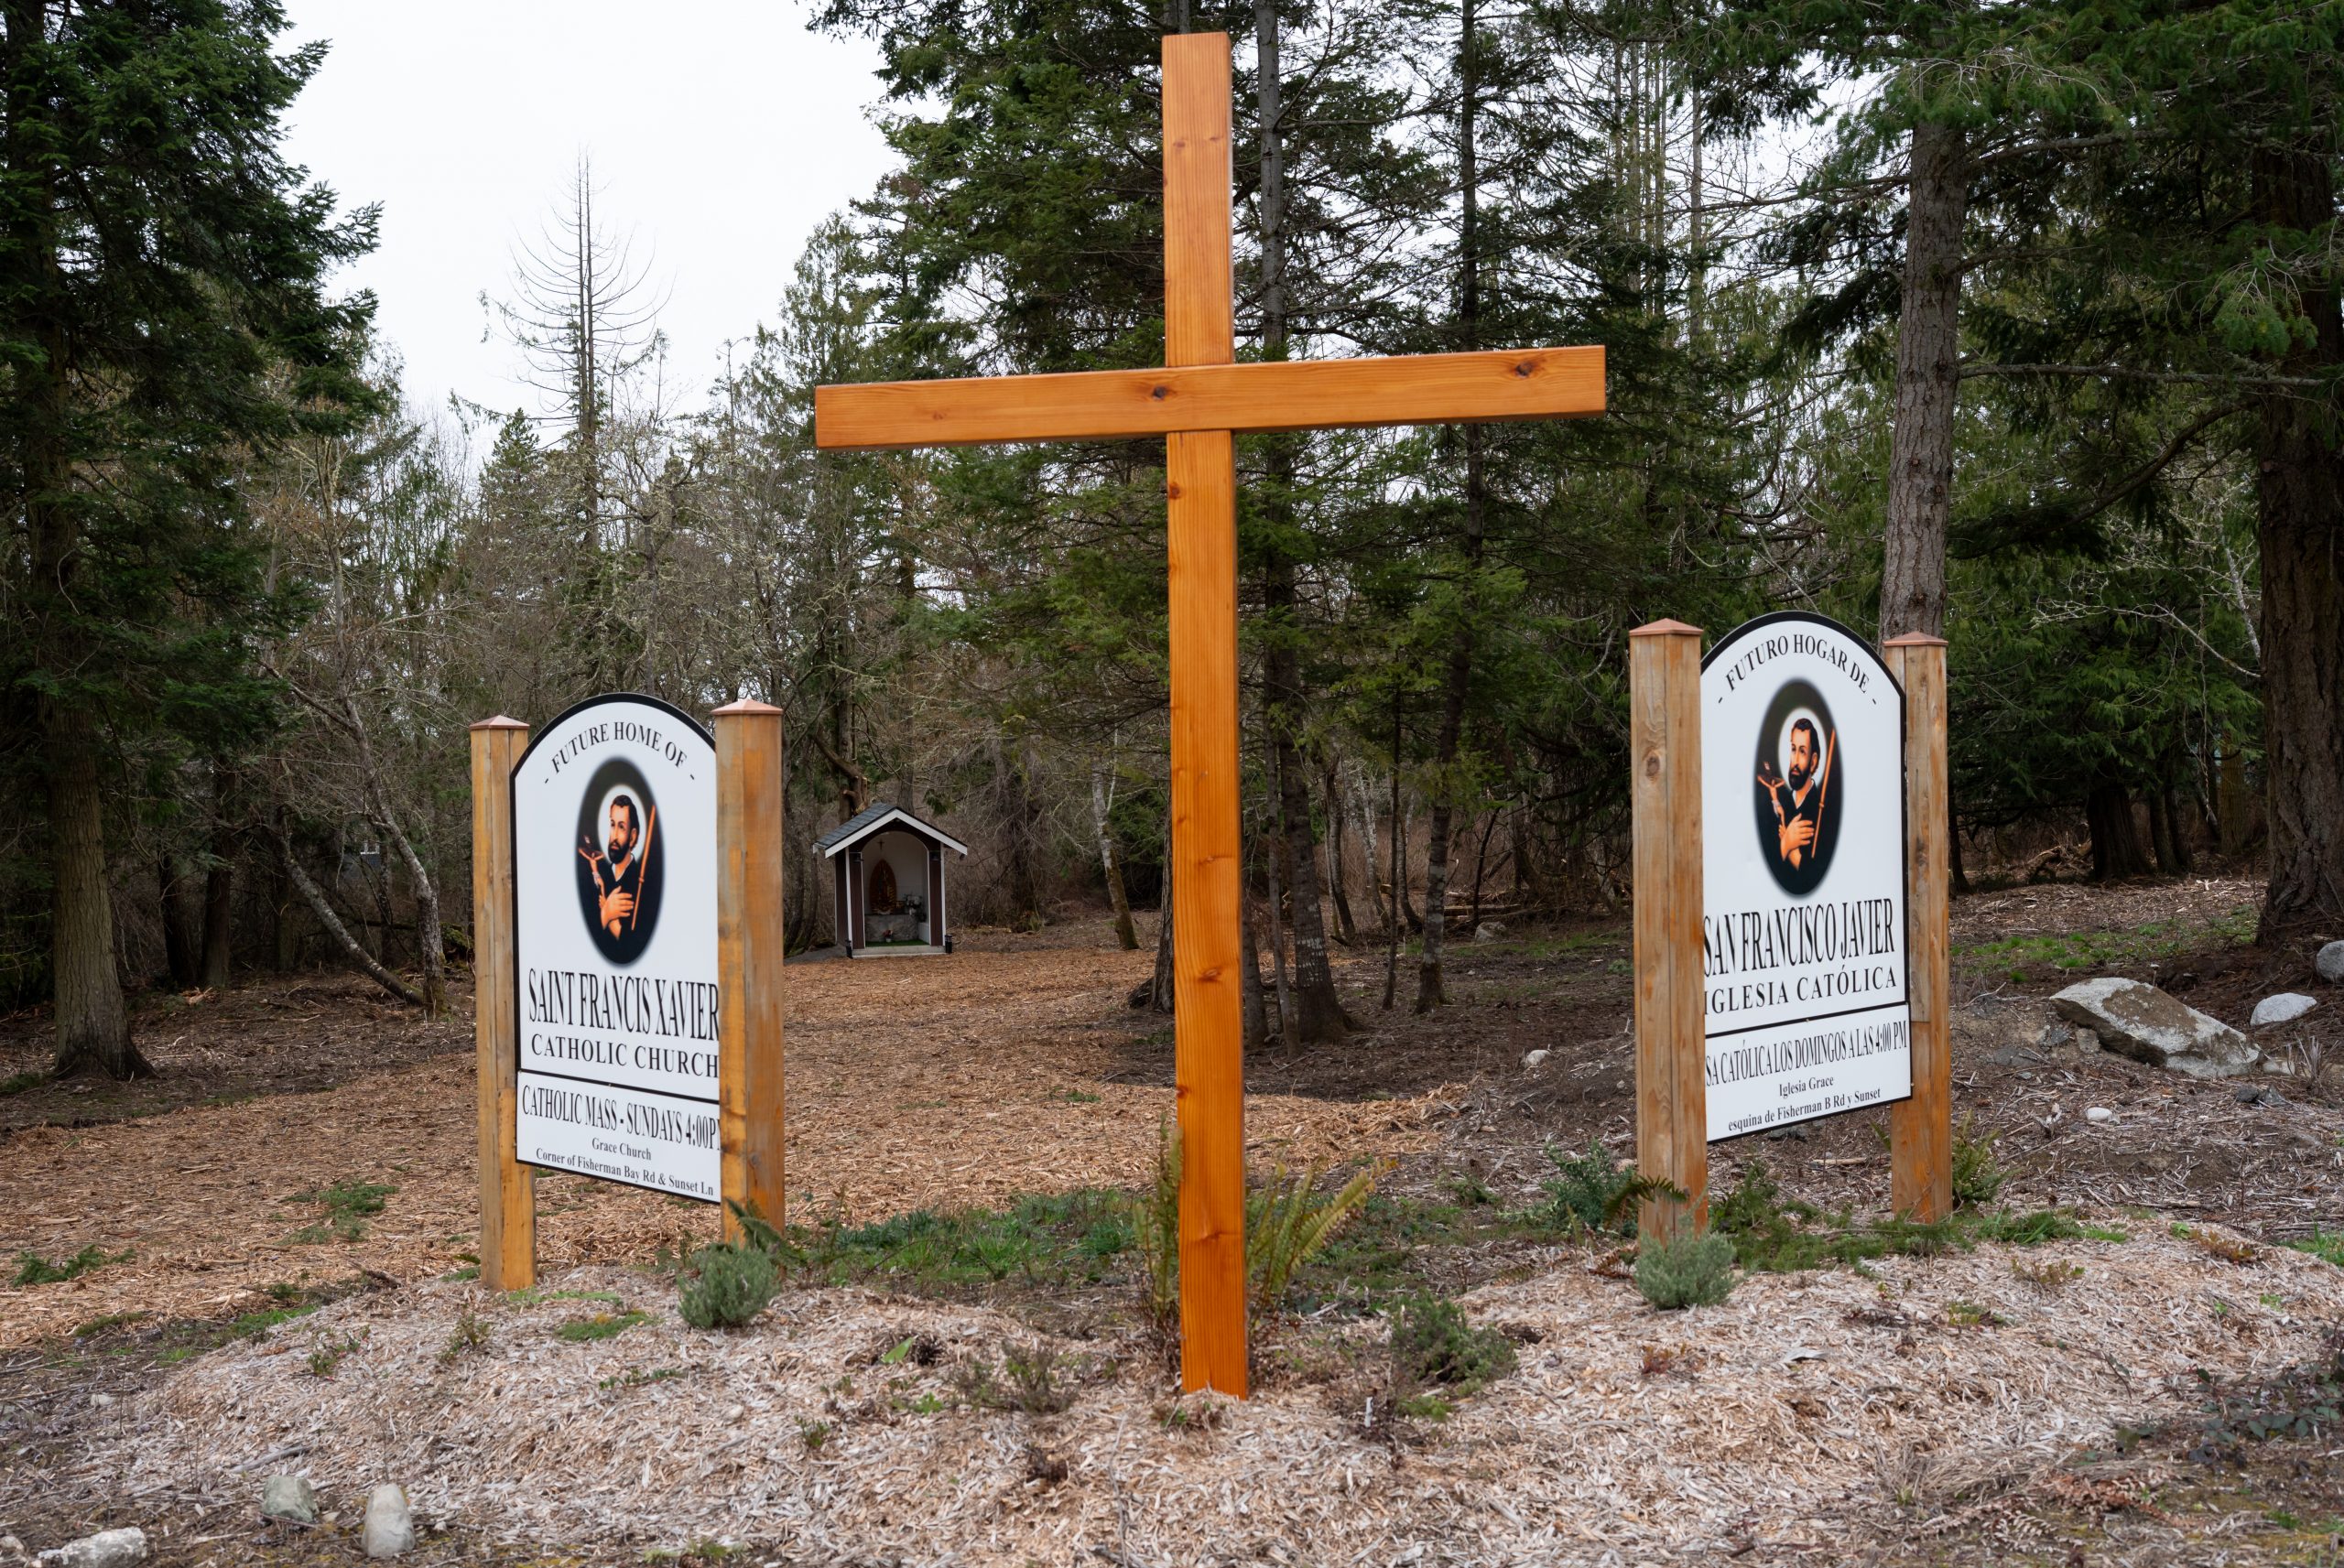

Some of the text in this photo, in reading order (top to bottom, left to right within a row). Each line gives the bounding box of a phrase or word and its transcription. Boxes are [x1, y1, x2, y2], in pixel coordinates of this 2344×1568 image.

[1725, 635, 1788, 692] FUTURO
[1793, 633, 1848, 672] HOGAR
[1849, 661, 1870, 694] DE
[550, 723, 610, 774] FUTURE
[613, 721, 663, 752] HOME
[665, 741, 688, 769] OF
[1704, 898, 1895, 978] SAN FRANCISCO JAVIER
[528, 968, 719, 1041] SAINT FRANCIS XAVIER
[1705, 964, 1896, 1015] IGLESIA CATÓLICA
[531, 1033, 719, 1078] CATHOLIC CHURCH
[1720, 1039, 1773, 1084] CATÓLICA
[1774, 1040, 1794, 1073] LOS
[1795, 1031, 1847, 1069] DOMINGOS
[1849, 1029, 1855, 1058] A
[1856, 1025, 1874, 1056] LAS
[1875, 1022, 1892, 1053] 4:00
[1893, 1020, 1907, 1050] PM
[1728, 1087, 1881, 1132] esquina de Fisherman B Rd y Sunset
[1779, 1076, 1834, 1098] Iglesia Grace
[522, 1085, 582, 1125] CATHOLIC
[585, 1095, 617, 1131] MASS
[626, 1102, 683, 1144] SUNDAYS
[686, 1113, 720, 1151] 4:00P
[536, 1147, 714, 1196] Corner of Fisherman Bay Rd & Sunset Ln
[591, 1137, 652, 1161] Grace Church
